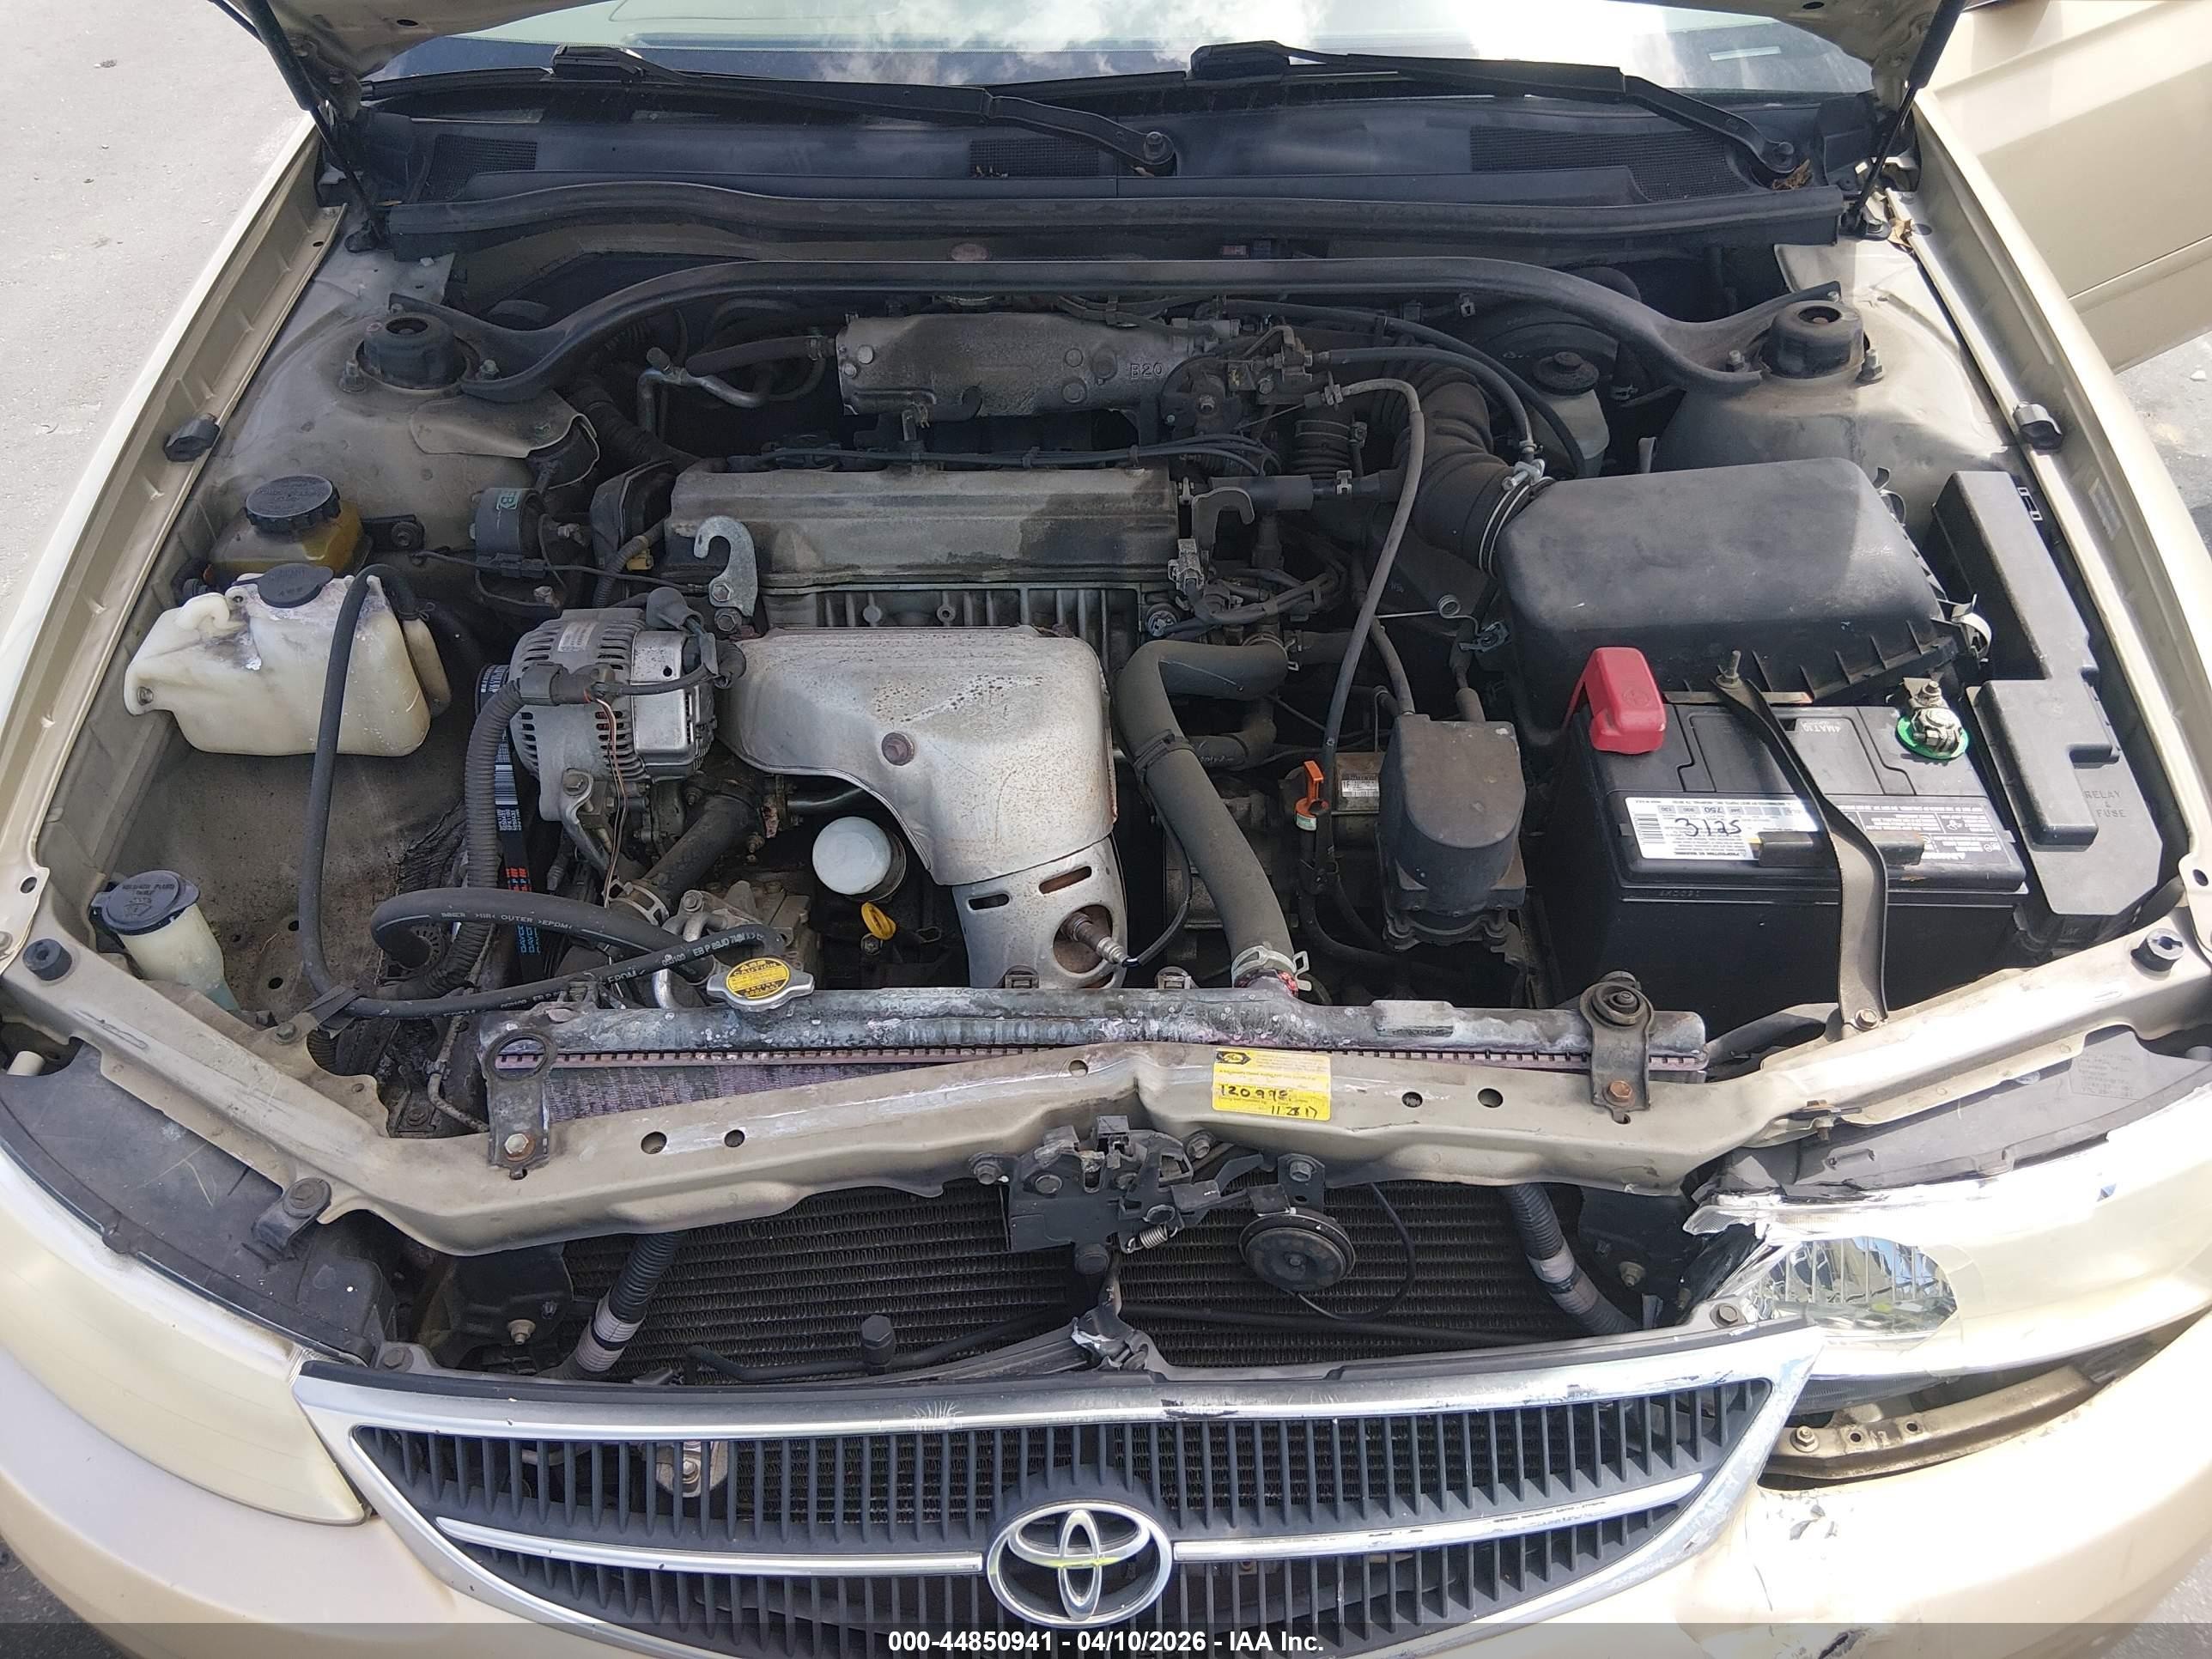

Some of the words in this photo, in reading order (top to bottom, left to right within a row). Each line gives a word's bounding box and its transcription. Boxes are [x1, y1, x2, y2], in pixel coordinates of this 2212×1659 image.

[1129, 362, 1163, 379] B20
[2083, 790, 2123, 799] RELAY
[2095, 809, 2127, 817] FUSE
[501, 915, 533, 923] OUTER
